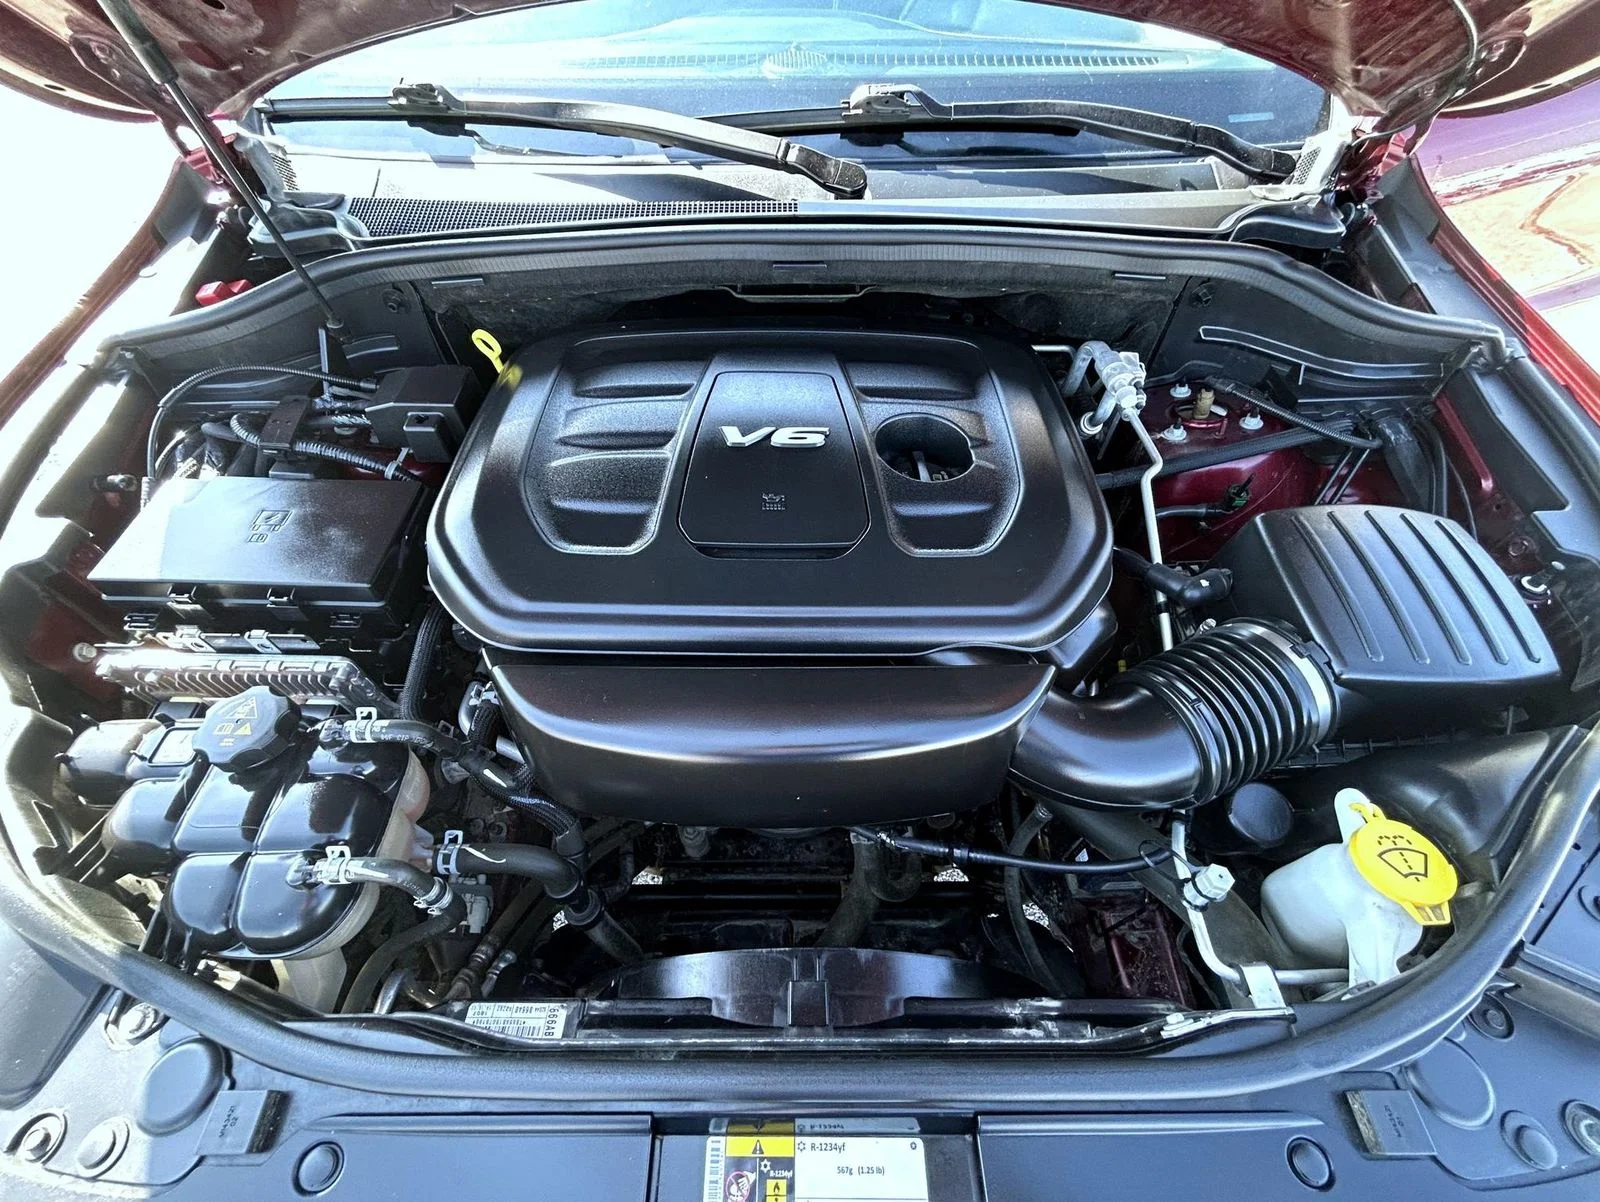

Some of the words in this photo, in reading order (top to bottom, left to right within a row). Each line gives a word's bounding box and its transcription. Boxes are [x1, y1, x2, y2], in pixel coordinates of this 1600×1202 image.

[719, 425, 830, 448] V6
[544, 1008, 559, 1037] 666AB
[811, 1142, 846, 1153] R-1234yf
[837, 1166, 853, 1176] 567g
[857, 1166, 875, 1176] (1.25
[876, 1166, 885, 1176] lb)
